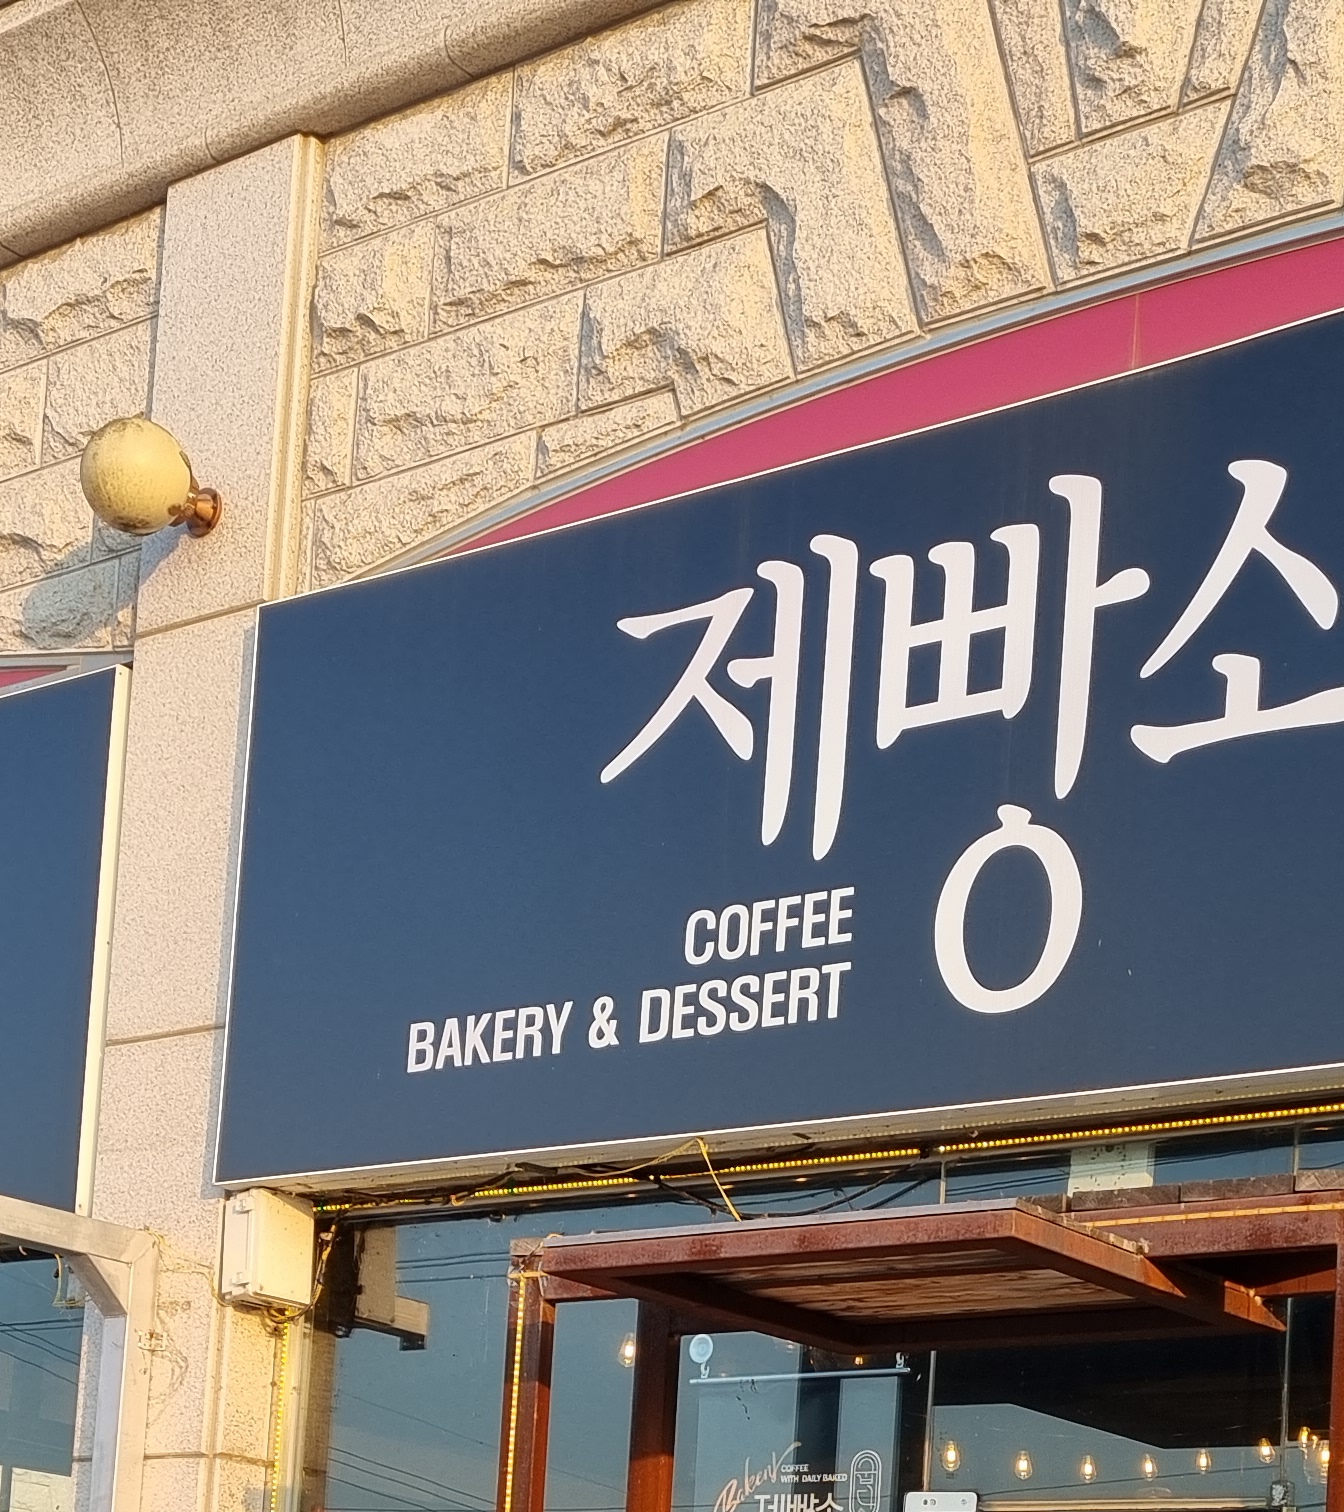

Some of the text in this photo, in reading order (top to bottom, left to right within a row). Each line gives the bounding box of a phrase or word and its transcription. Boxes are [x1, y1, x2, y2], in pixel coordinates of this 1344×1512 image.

[683, 885, 855, 967] COFFEE
[405, 961, 852, 1074] BAKERY & DESSERT
[780, 1463, 810, 1473] COFFEE
[780, 1473, 848, 1483] WITH DAILY BAKED
